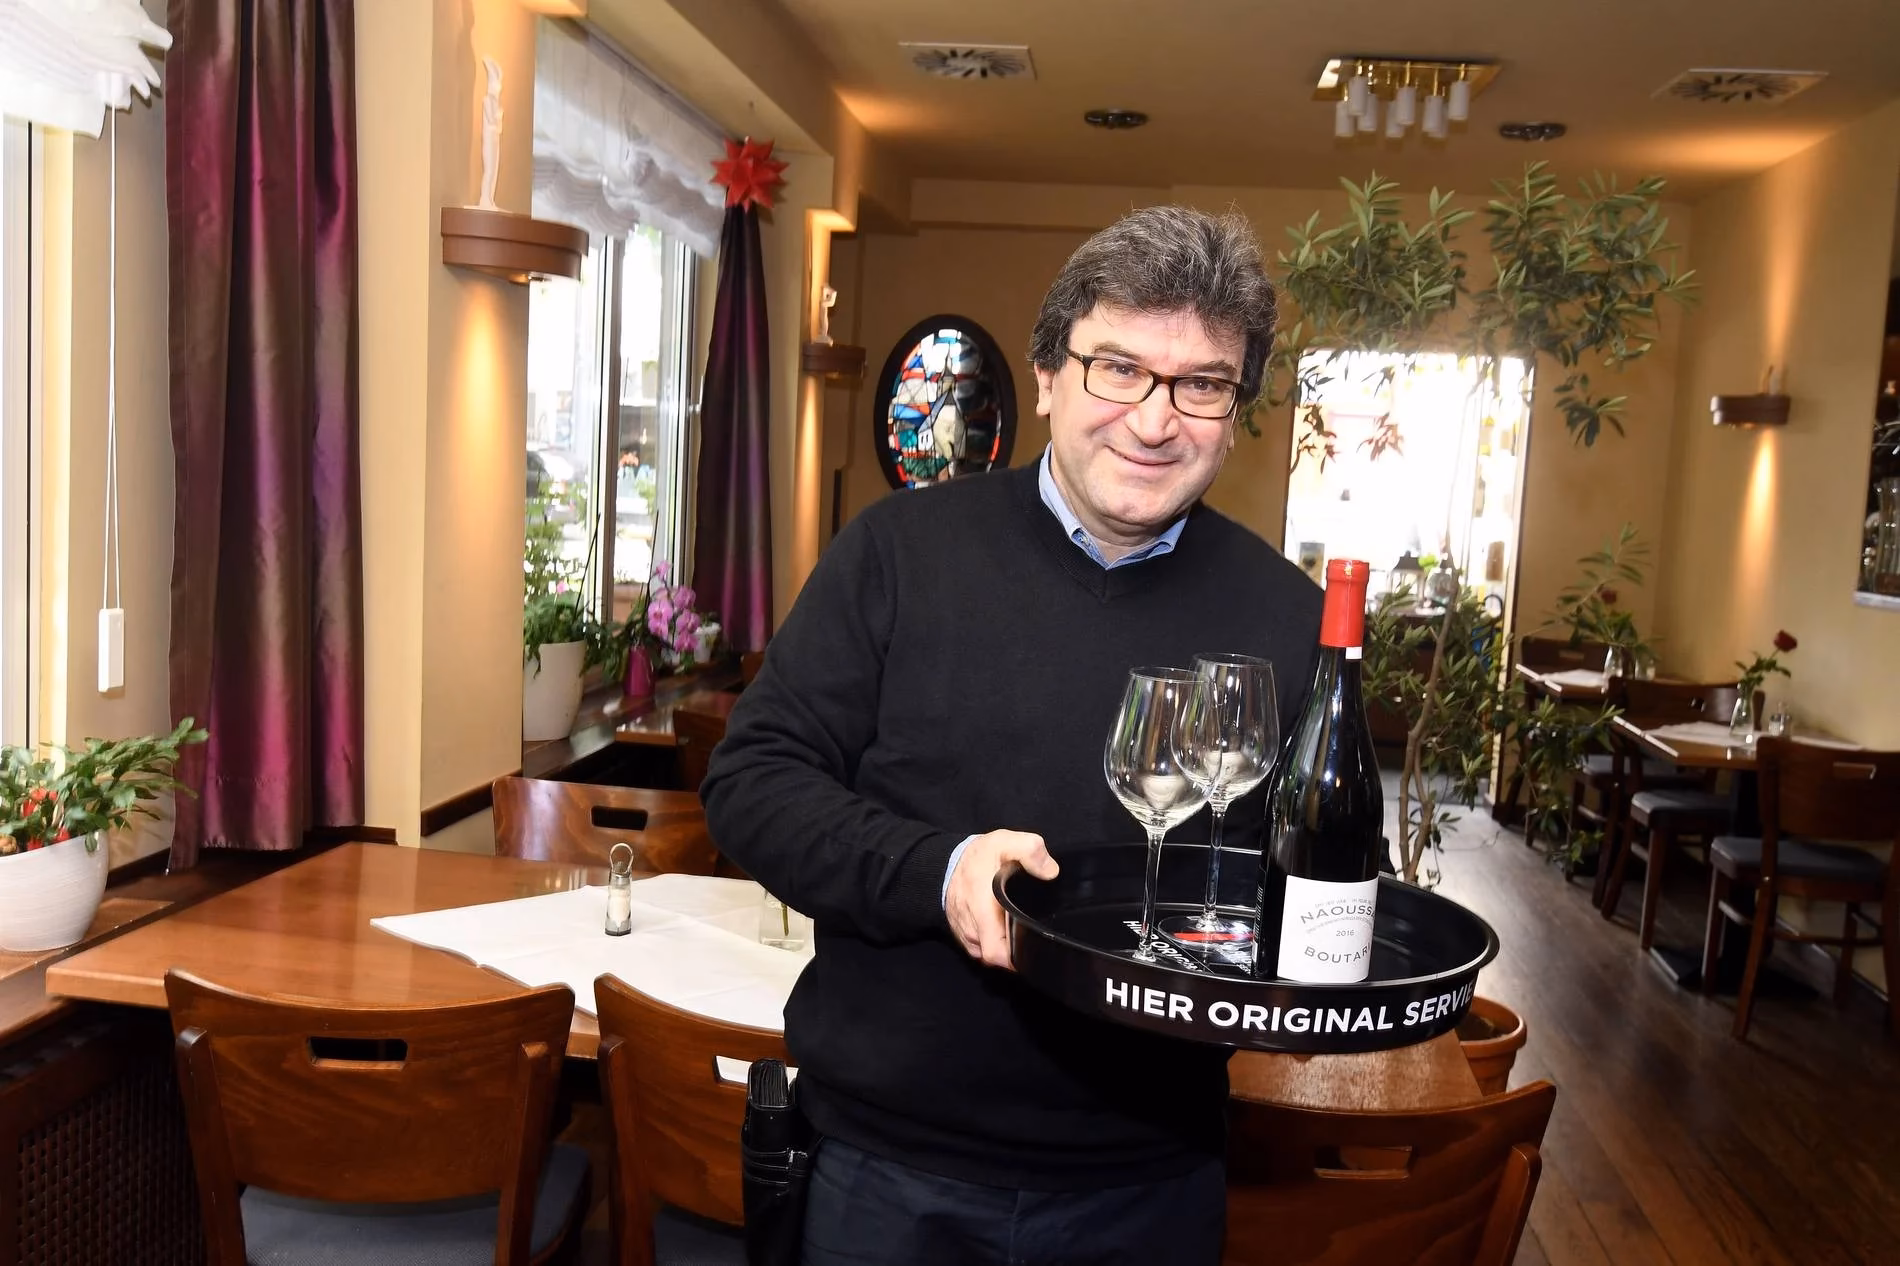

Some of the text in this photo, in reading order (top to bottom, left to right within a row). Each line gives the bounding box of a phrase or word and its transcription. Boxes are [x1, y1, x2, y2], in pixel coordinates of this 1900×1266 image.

[1335, 929, 1355, 937] 2016
[1106, 977, 1193, 1022] HIER
[1208, 1001, 1393, 1033] ORIGINAL
